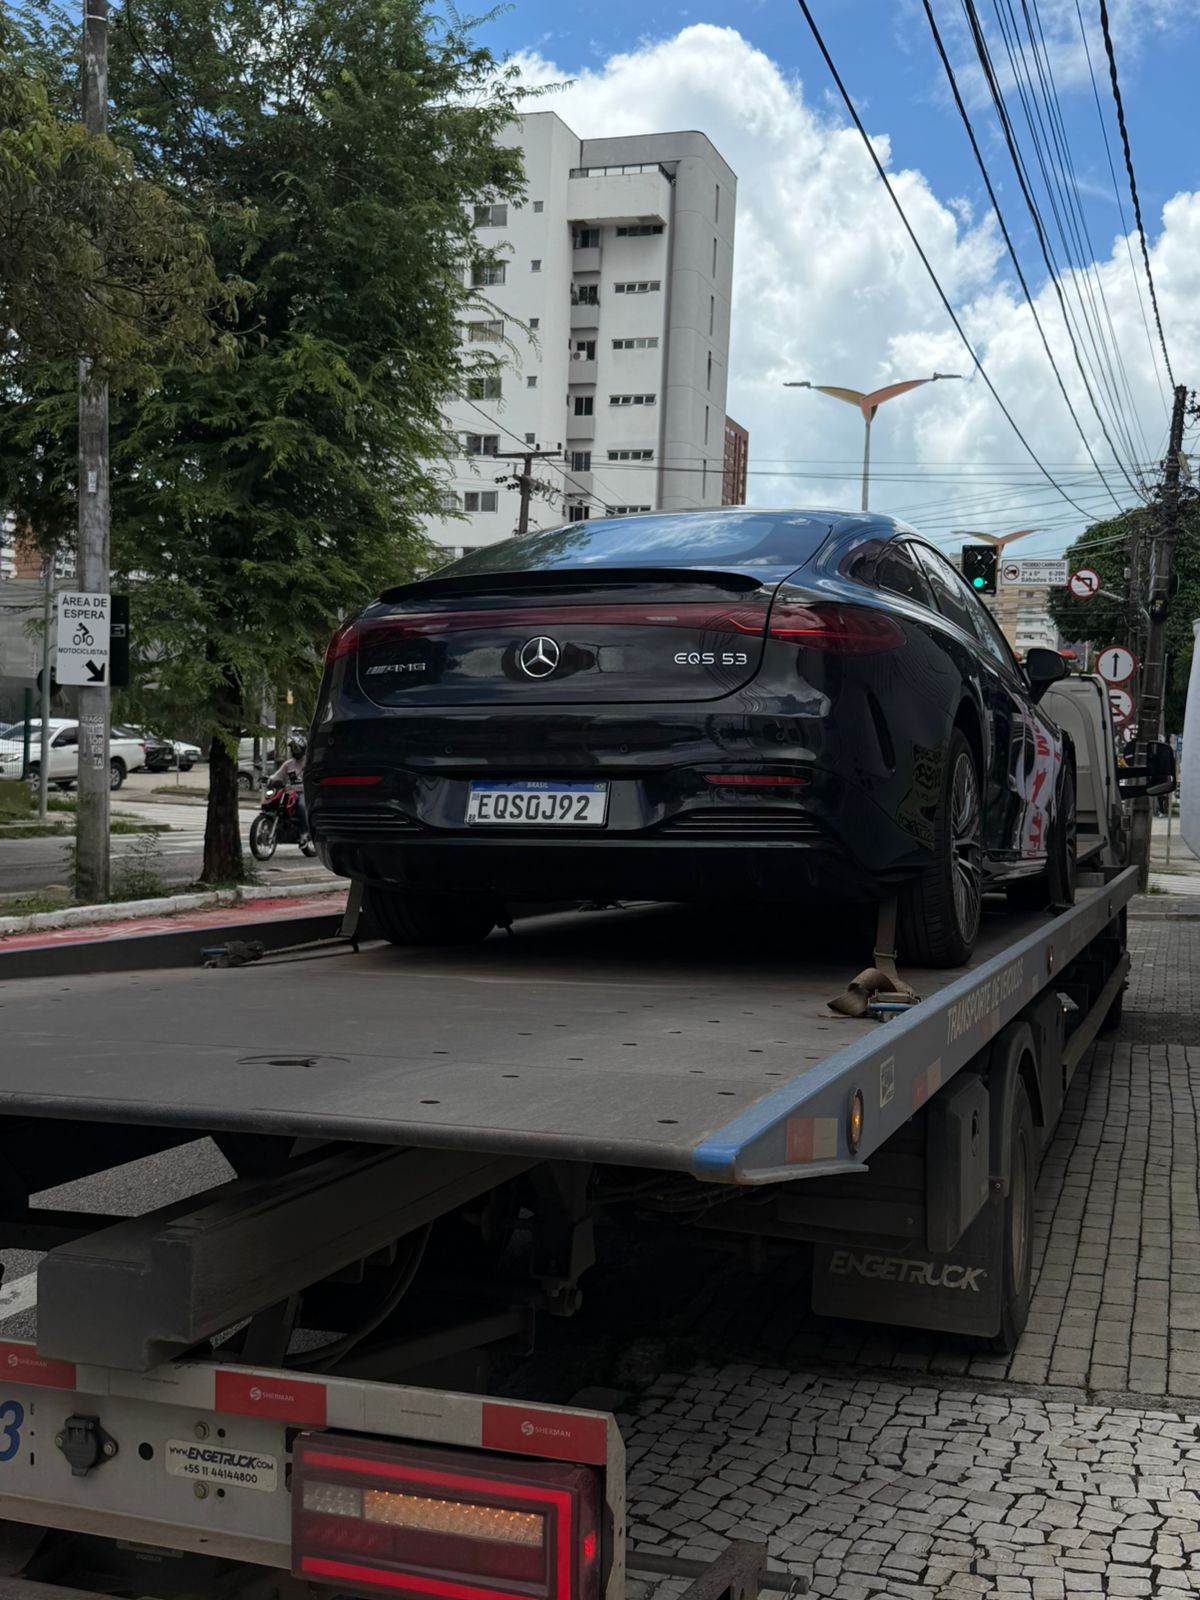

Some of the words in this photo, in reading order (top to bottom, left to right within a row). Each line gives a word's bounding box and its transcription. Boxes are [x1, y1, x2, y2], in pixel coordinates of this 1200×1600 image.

[62, 594, 91, 607] ÁREA
[93, 597, 108, 608] DE
[63, 608, 106, 620] ESPERA
[58, 647, 108, 656] MOTOCICLISTAS
[674, 652, 715, 665] EQS
[721, 652, 748, 665] 53
[386, 662, 427, 673] AMG
[526, 781, 549, 789] BRASIL
[828, 1250, 984, 1292] ENGETRUCK
[262, 1391, 295, 1402] SHERMAN
[535, 1426, 571, 1438] SHERMAN
[183, 1463, 200, 1474] +55
[202, 1466, 208, 1476] 11
[211, 1468, 258, 1484] 44144800
